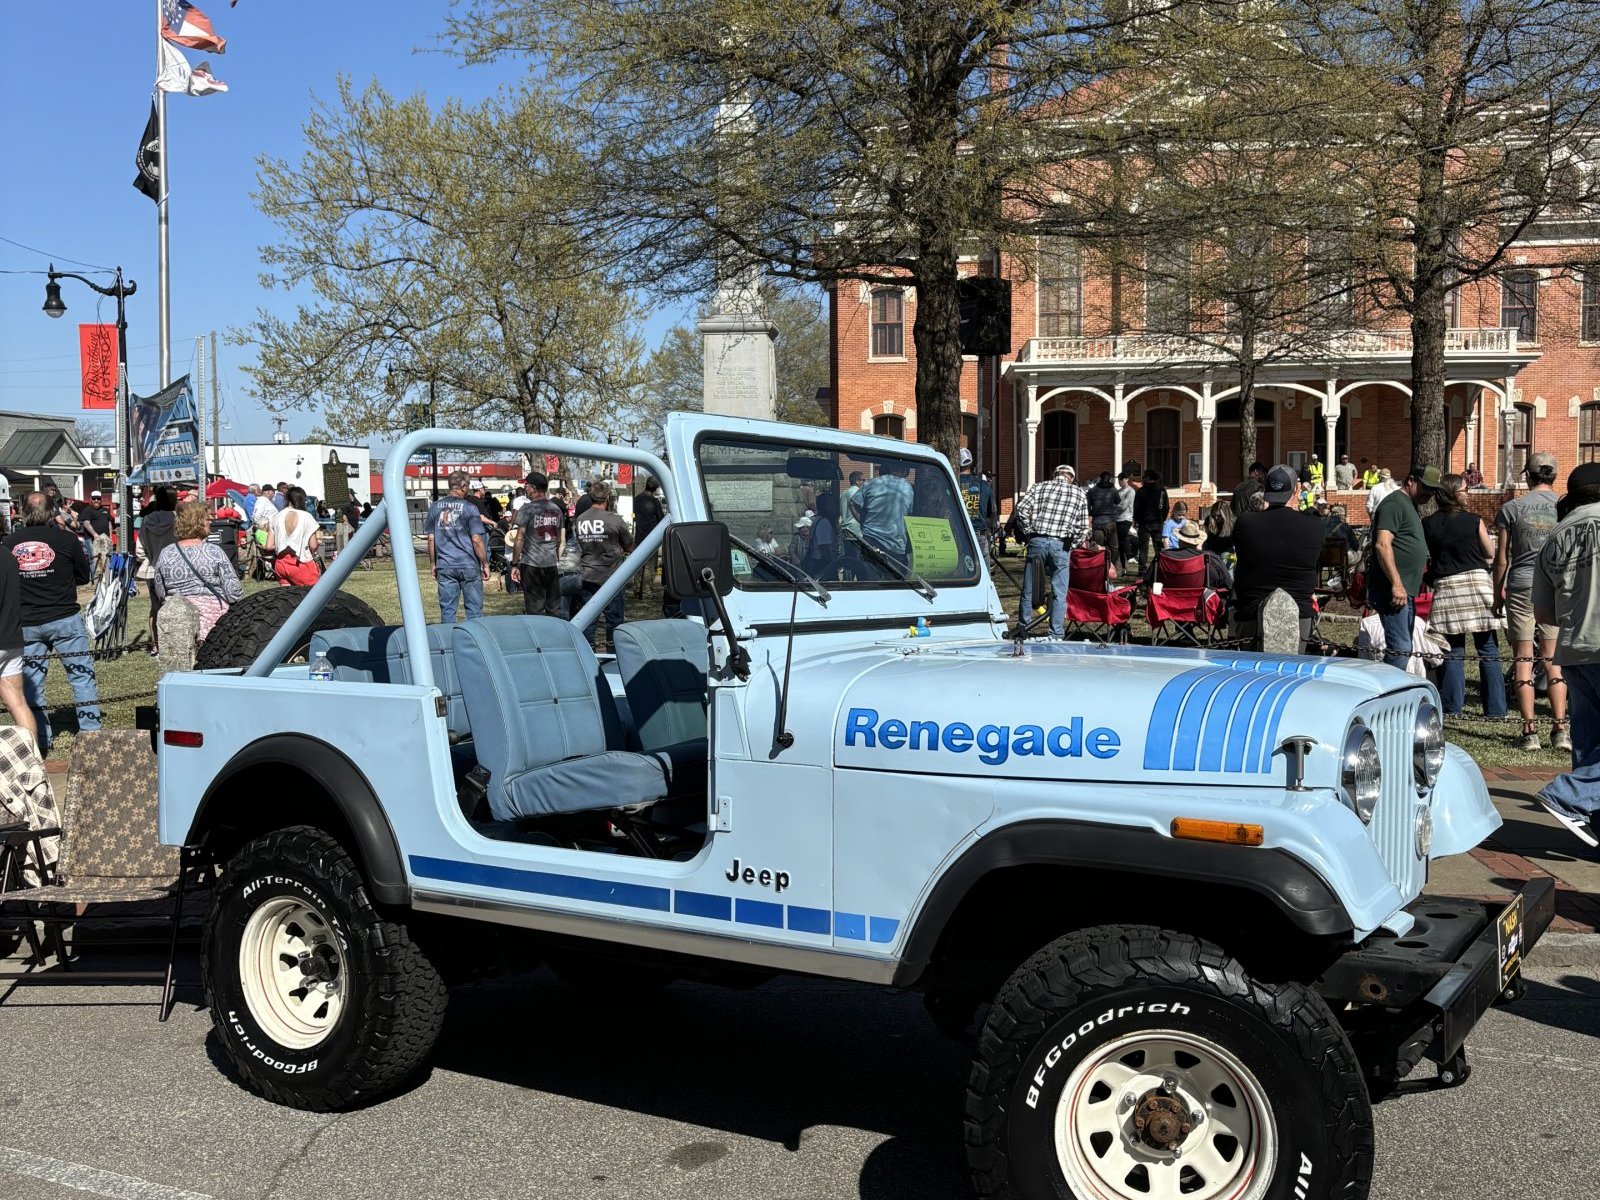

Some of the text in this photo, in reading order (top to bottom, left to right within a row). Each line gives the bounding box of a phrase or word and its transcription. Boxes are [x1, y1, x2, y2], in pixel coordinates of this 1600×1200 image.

[578, 520, 605, 535] KNB
[844, 708, 1121, 766] Renegade
[243, 875, 327, 909] All-Terrain
[726, 858, 791, 893] Jeep
[228, 1010, 319, 1075] BFGoodrich
[1025, 1001, 1191, 1109] BFGoodrich
[1294, 1151, 1313, 1200] All
